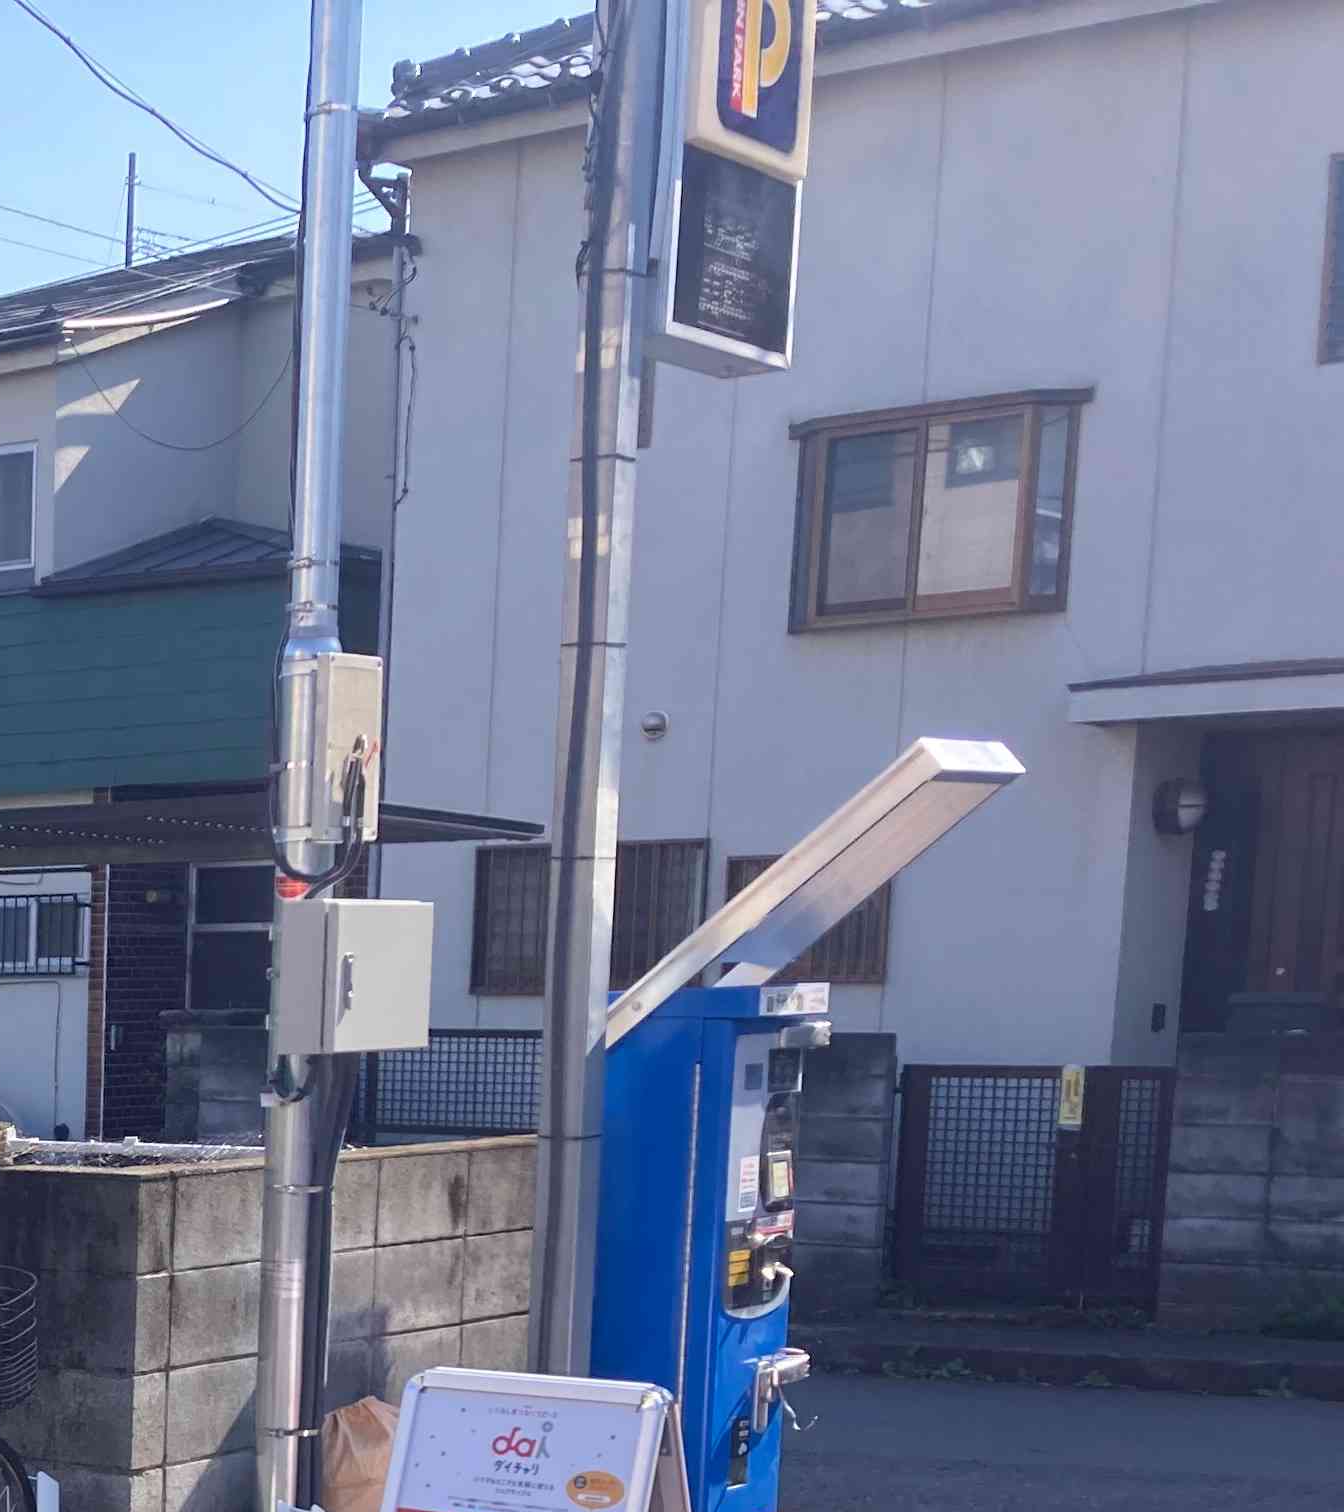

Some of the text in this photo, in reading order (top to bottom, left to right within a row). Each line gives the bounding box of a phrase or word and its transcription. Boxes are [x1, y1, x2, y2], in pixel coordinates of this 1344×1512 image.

[491, 1421, 554, 1459] dai
[493, 1460, 540, 1476] ダイチャリ
